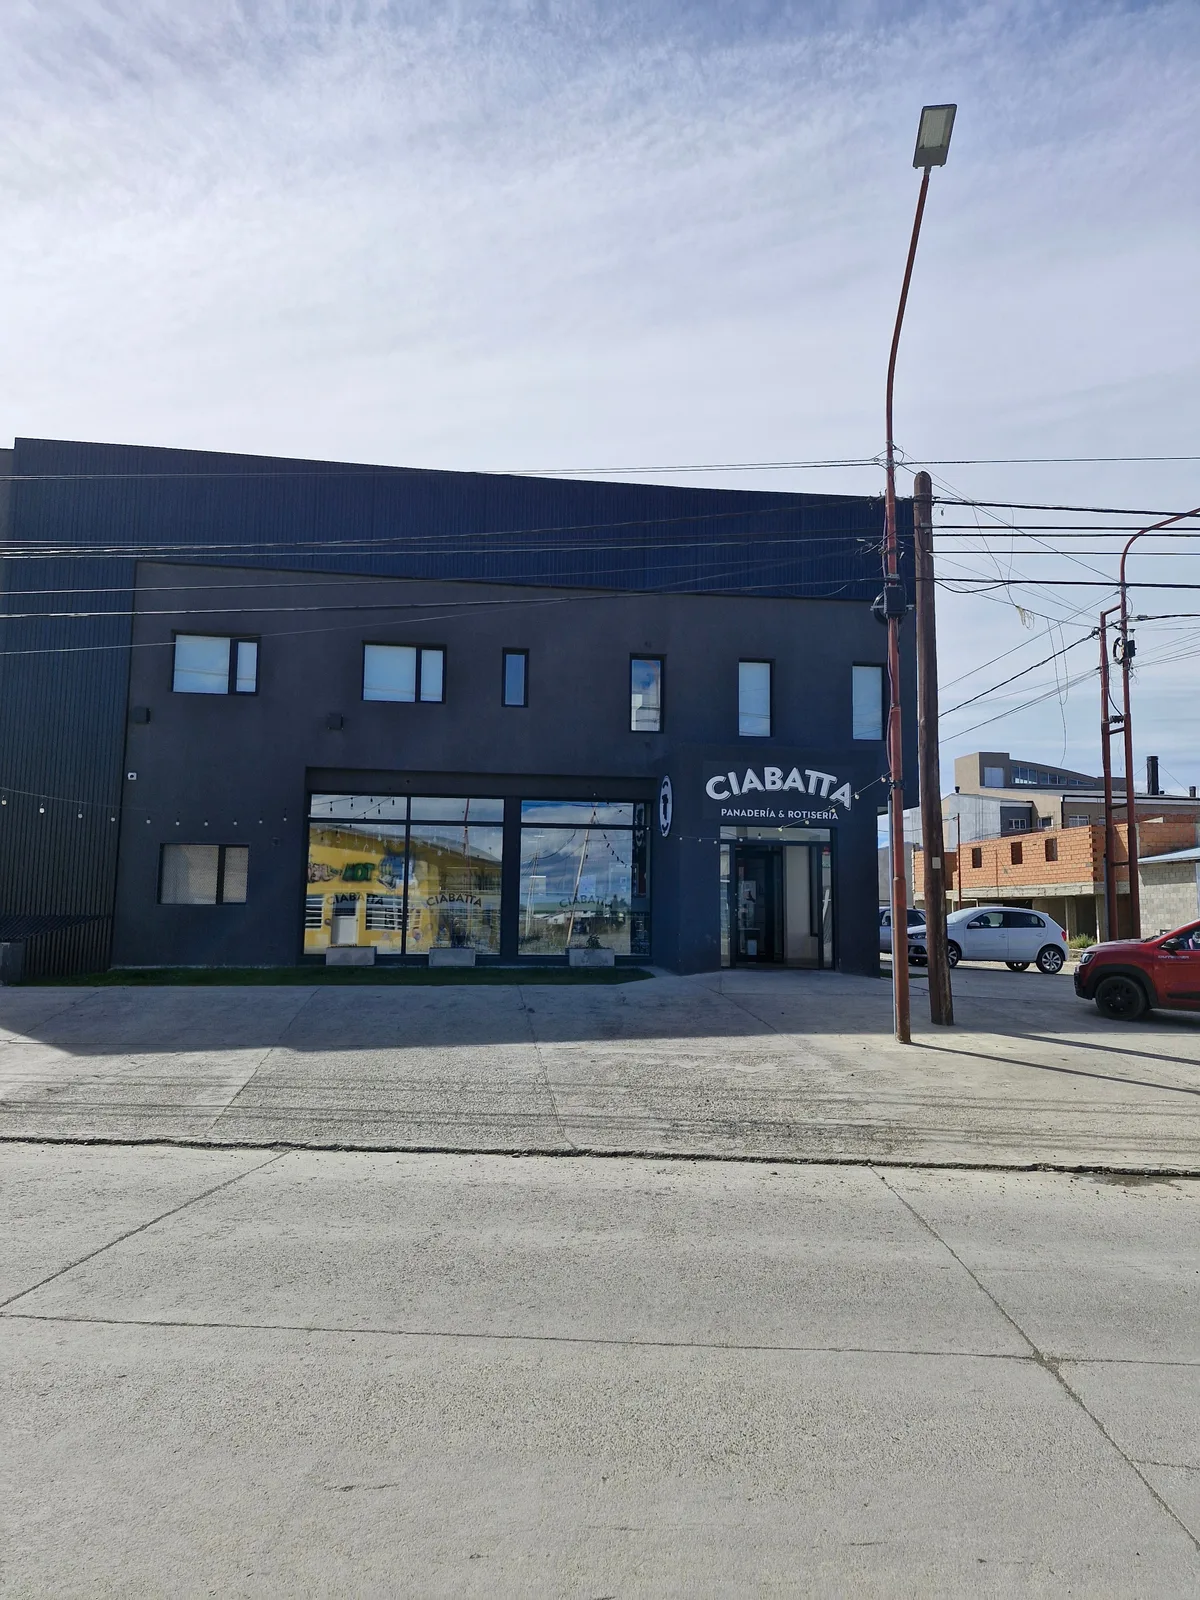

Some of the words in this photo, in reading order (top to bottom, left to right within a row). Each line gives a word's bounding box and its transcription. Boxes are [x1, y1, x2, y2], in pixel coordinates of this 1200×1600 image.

[705, 766, 852, 811] CIABATTA
[721, 808, 776, 818] PANADERÍA
[788, 810, 839, 820] ROTISERÍA
[326, 892, 384, 906] CIABATTA
[426, 892, 482, 908] CIABATTA
